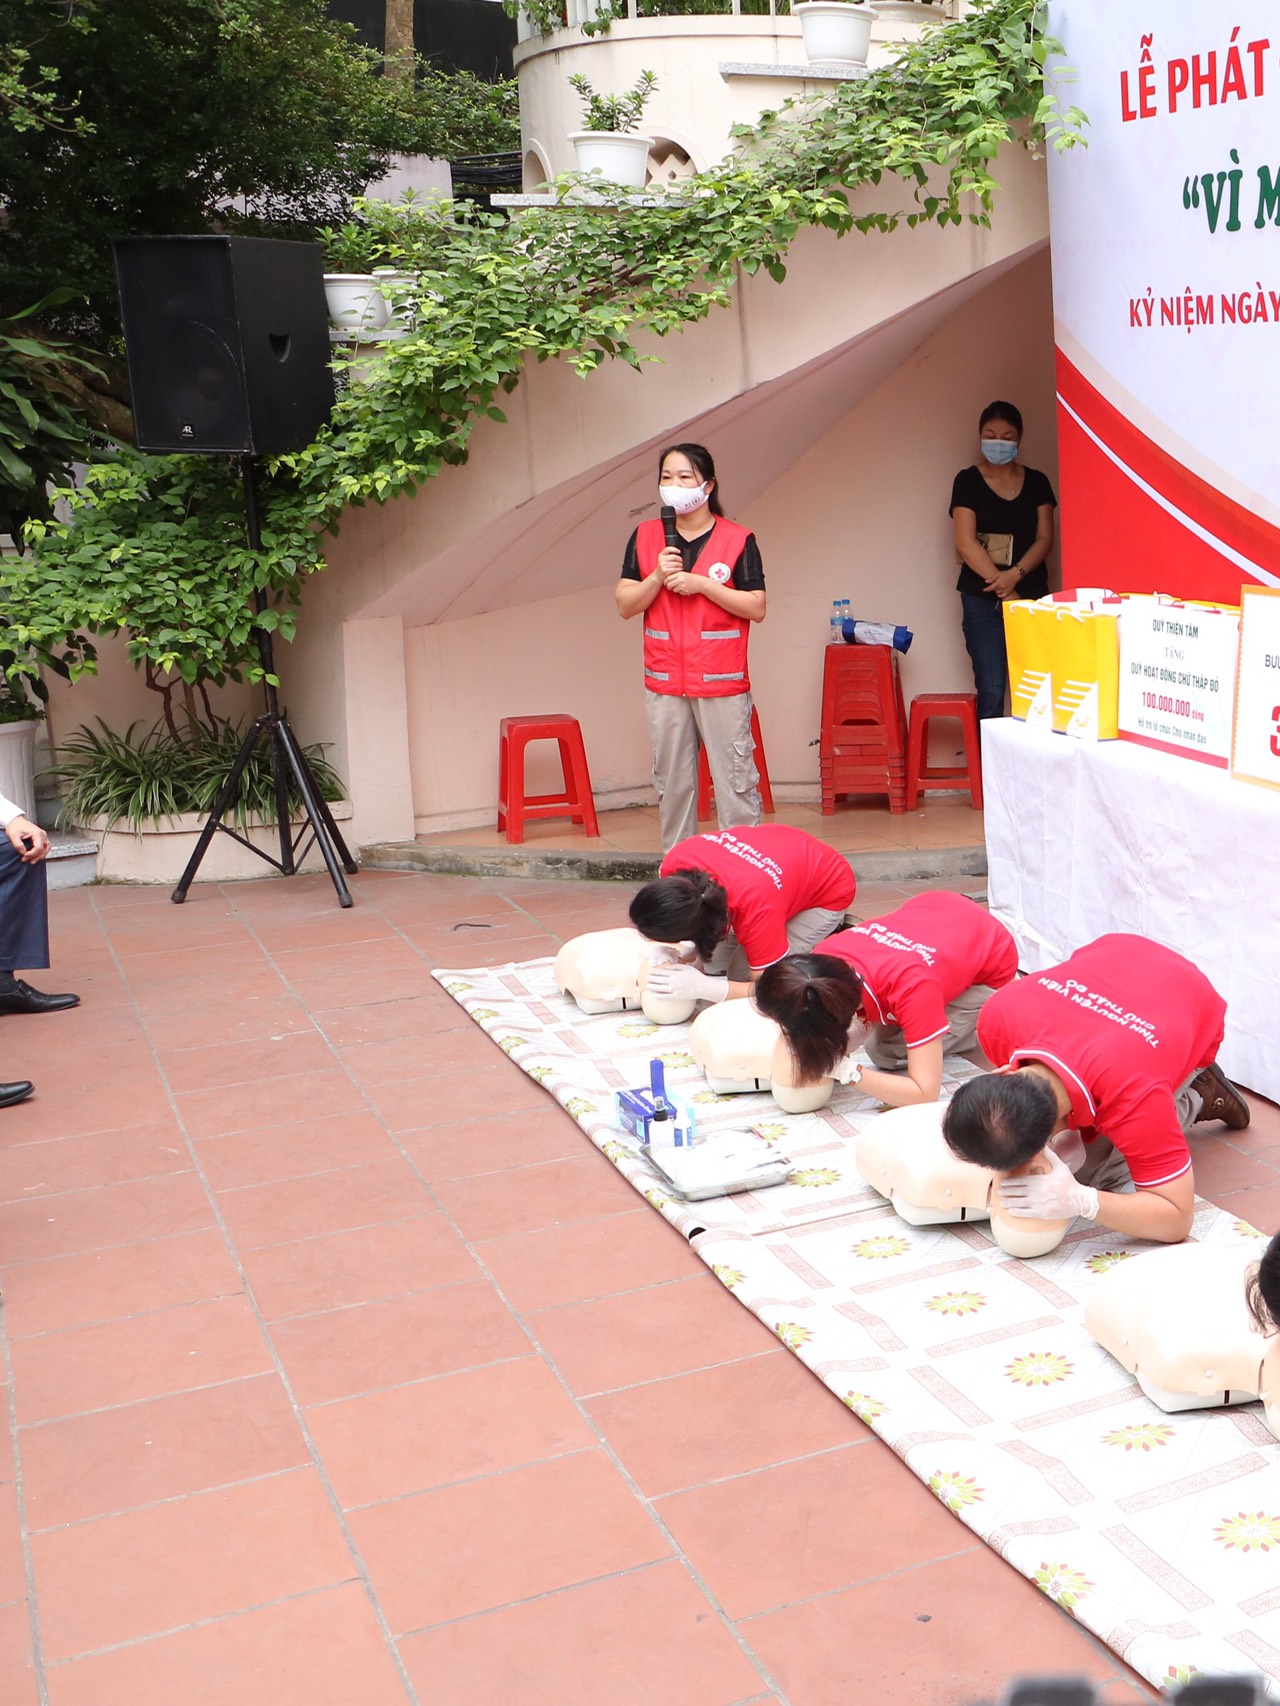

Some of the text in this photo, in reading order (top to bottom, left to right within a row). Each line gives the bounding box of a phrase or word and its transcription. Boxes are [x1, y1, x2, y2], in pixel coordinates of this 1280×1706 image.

[1121, 33, 1157, 122] LỄ
[1168, 26, 1270, 113] PHÁT
[1130, 286, 1154, 327] KỶ
[1161, 286, 1214, 334] NIỆM
[1142, 691, 1190, 717] 100.000.000
[1066, 979, 1088, 992] ĐỎ
[1088, 992, 1123, 1014] THẬP
[1038, 977, 1160, 1048] TÌNH NGUYỆN VIÊN
